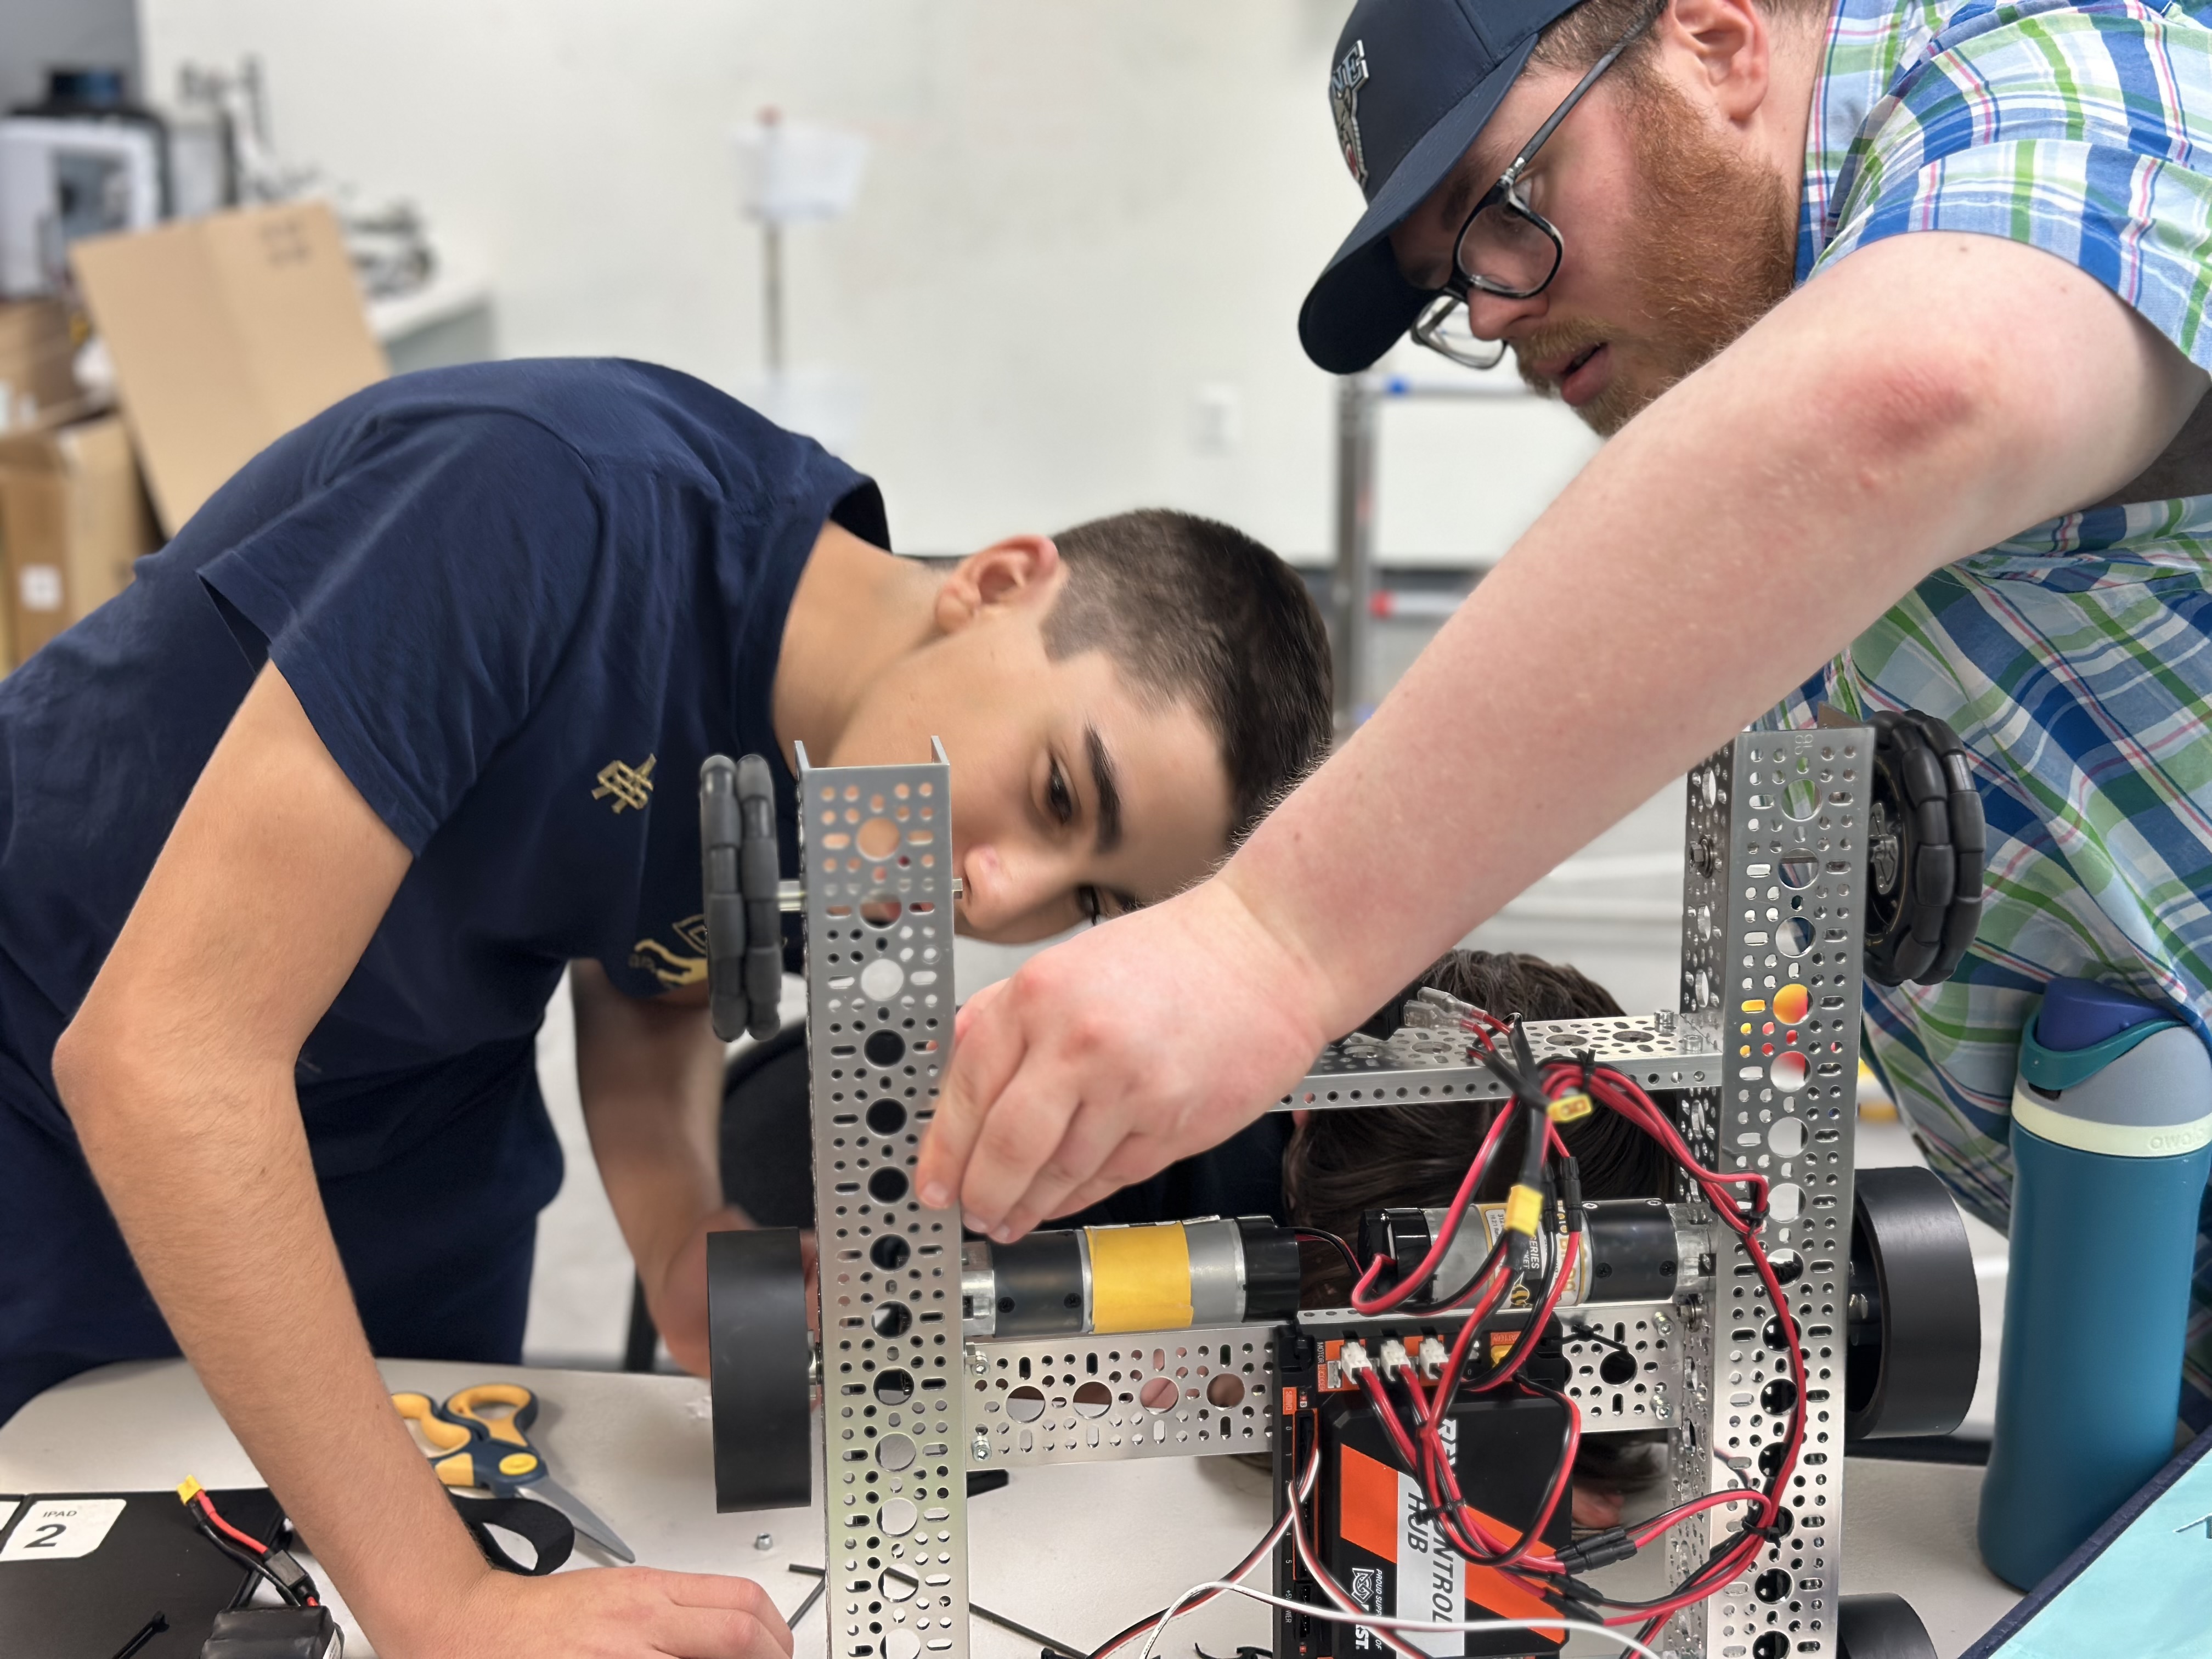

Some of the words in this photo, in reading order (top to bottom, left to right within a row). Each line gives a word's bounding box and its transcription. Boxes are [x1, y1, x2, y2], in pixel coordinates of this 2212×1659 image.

[1437, 1419, 1456, 1477] RE
[42, 1510, 77, 1518] IPAD
[23, 1523, 67, 1549] 2
[1432, 1536, 1454, 1623] NTROL
[1375, 1639, 1382, 1650] OF
